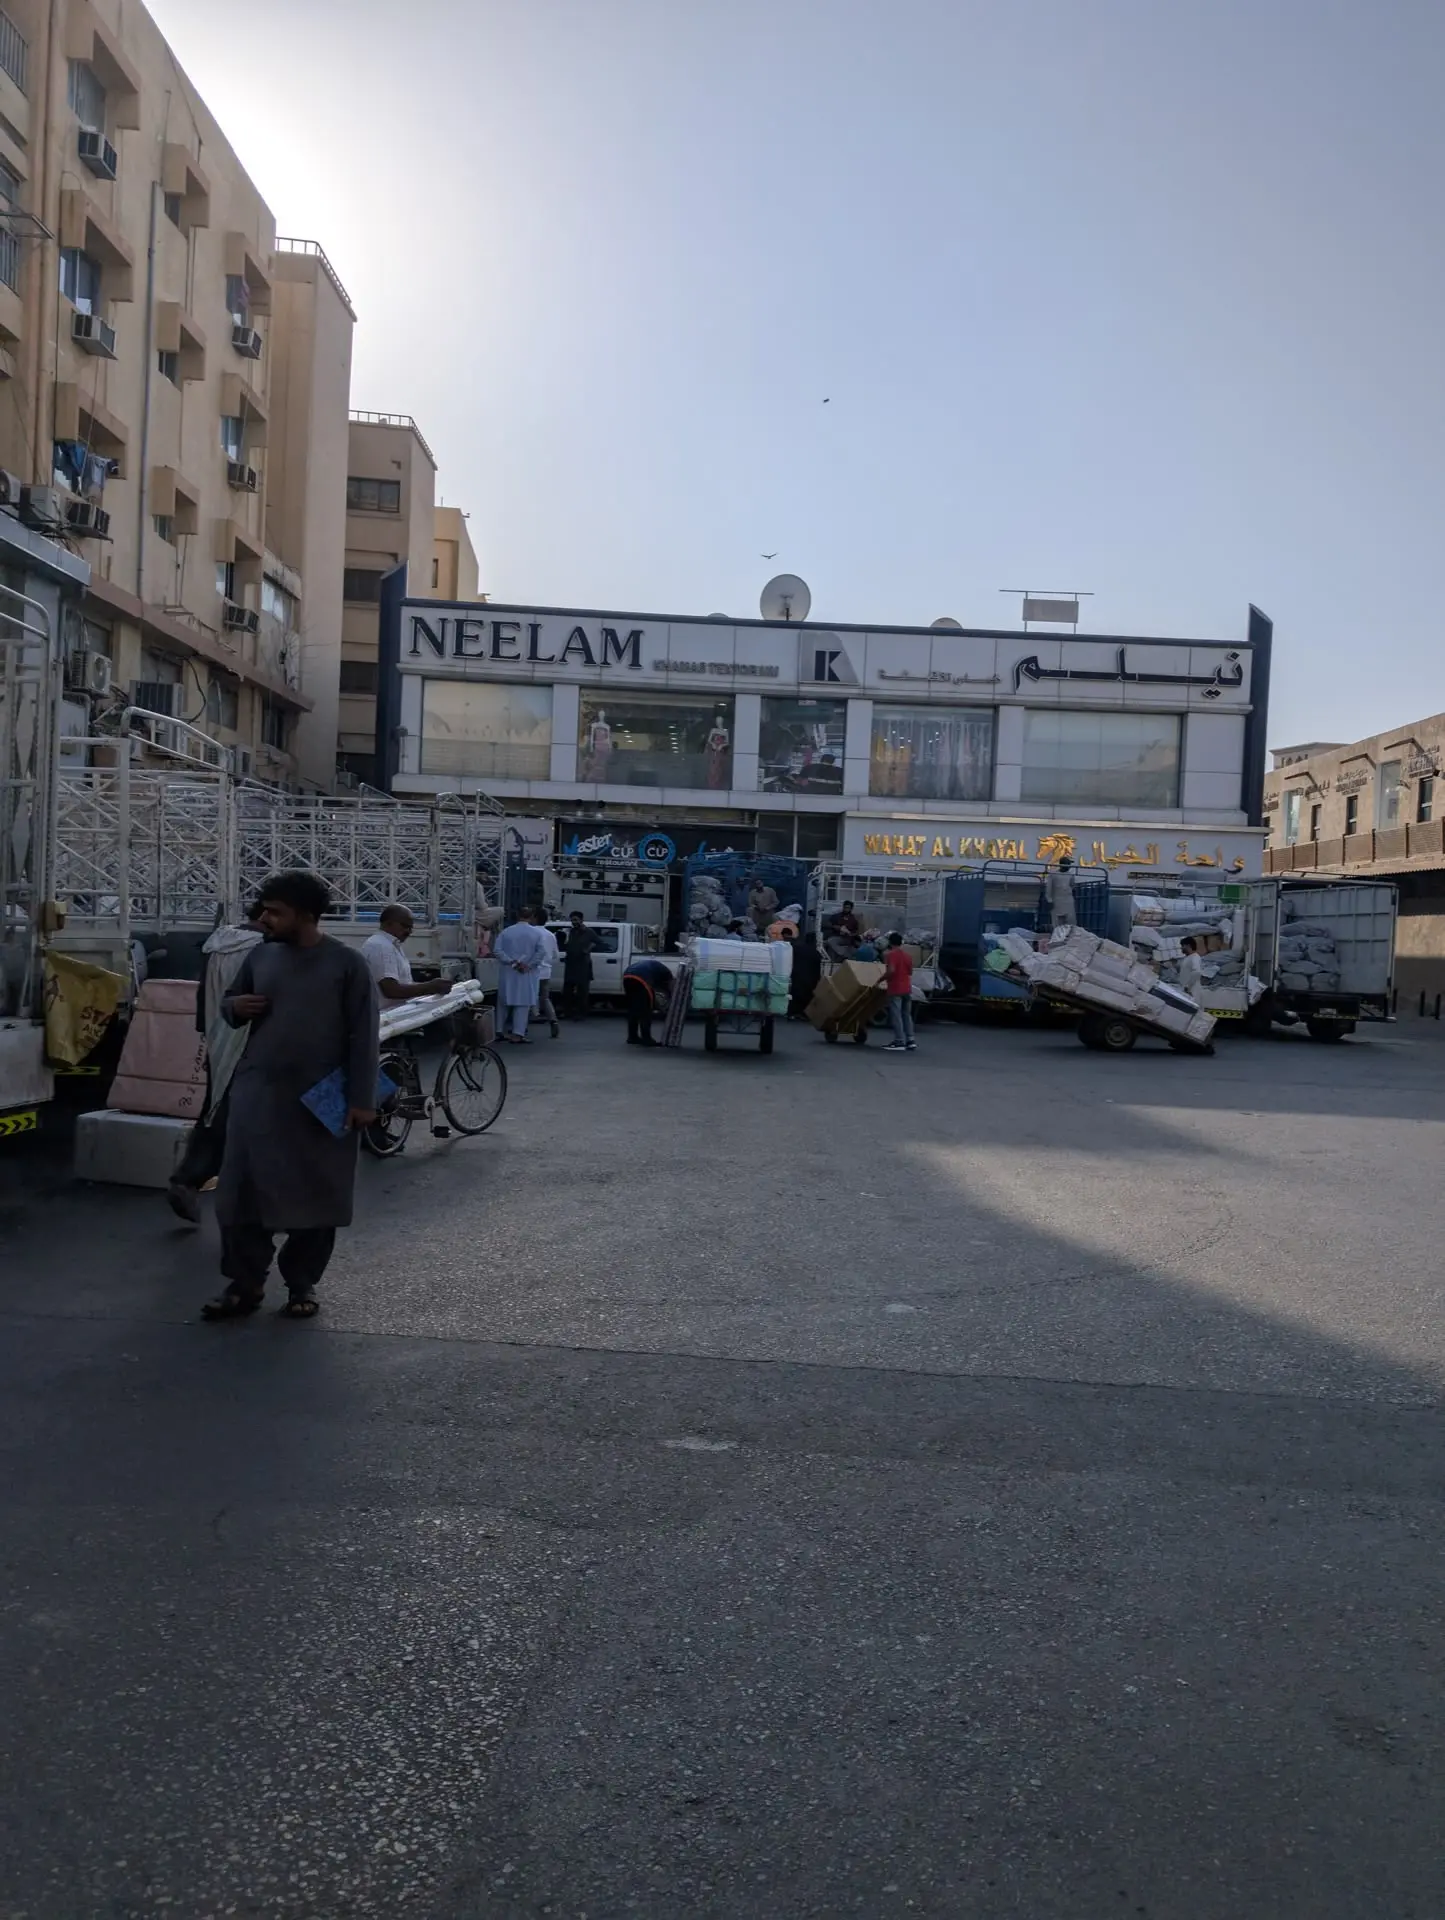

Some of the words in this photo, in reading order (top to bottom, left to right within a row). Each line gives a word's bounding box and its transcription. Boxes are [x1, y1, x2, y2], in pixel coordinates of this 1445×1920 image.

[409, 616, 644, 669] NEELAM
[611, 846, 635, 858] CUP
[646, 846, 669, 858] CUP
[864, 834, 926, 856] WAHAT
[932, 836, 954, 857] AL
[959, 837, 1028, 860] KHAYAL
